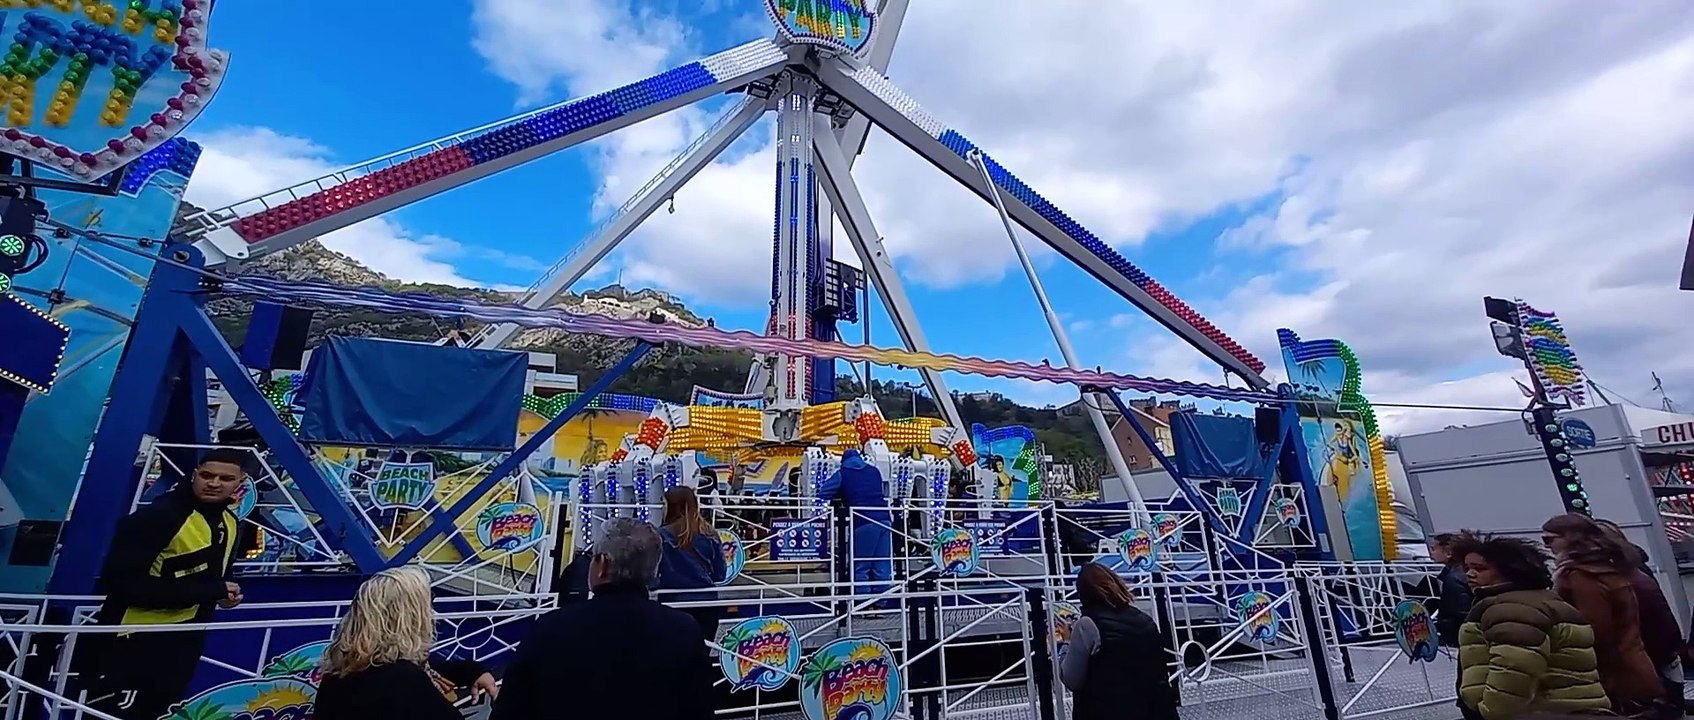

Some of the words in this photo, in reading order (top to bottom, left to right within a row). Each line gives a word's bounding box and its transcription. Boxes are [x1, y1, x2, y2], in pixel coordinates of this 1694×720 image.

[383, 467, 429, 480] BEACH
[377, 479, 428, 504] PARTY
[738, 632, 791, 657] Beach
[823, 658, 889, 699] Beach
